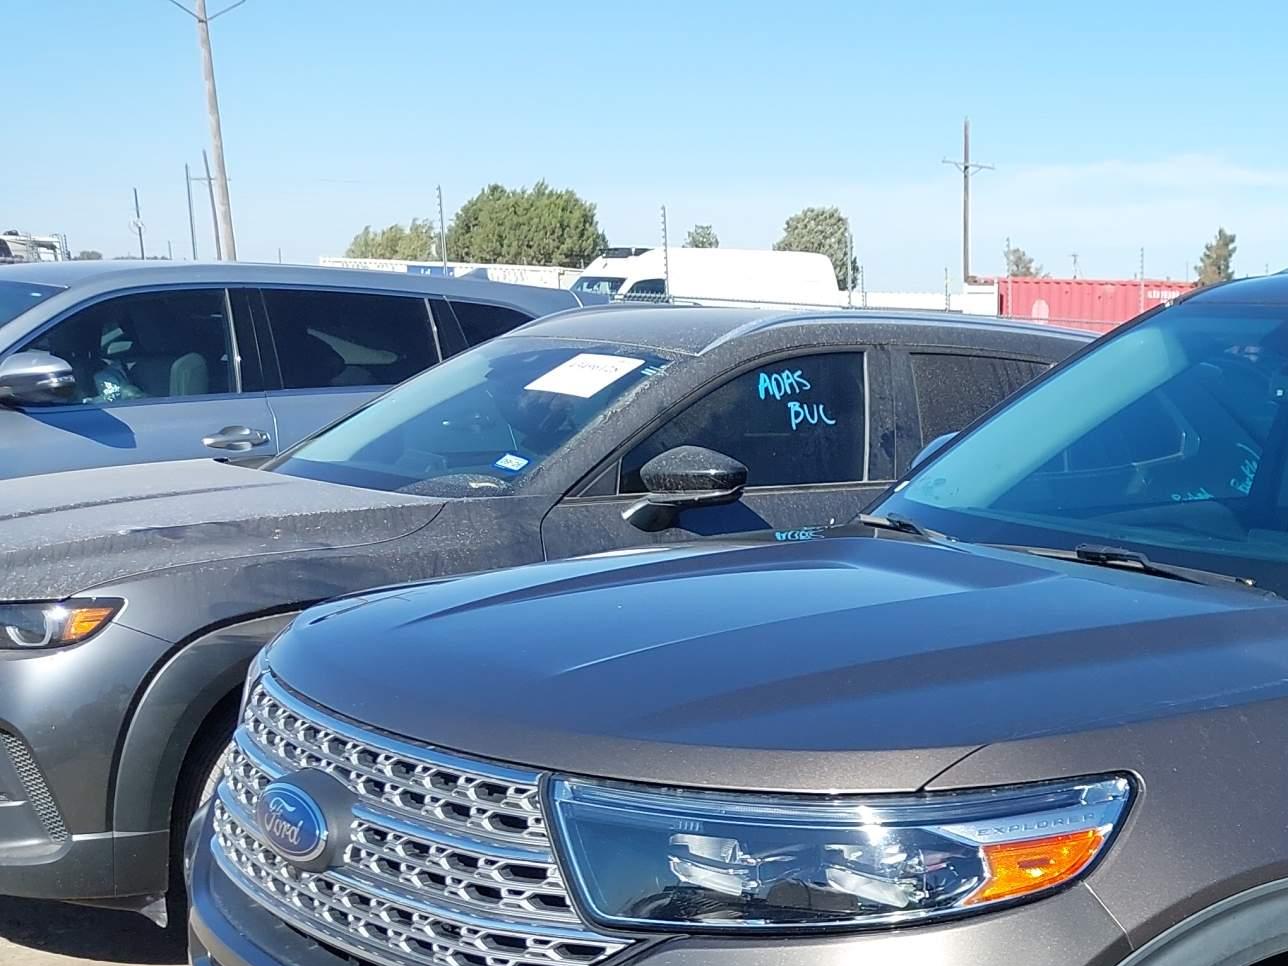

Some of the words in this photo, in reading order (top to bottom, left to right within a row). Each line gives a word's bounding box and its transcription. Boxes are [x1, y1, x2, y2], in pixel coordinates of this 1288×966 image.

[758, 369, 811, 400] ADAS
[264, 796, 304, 846] Ford
[975, 812, 1096, 836] EXPLORER
